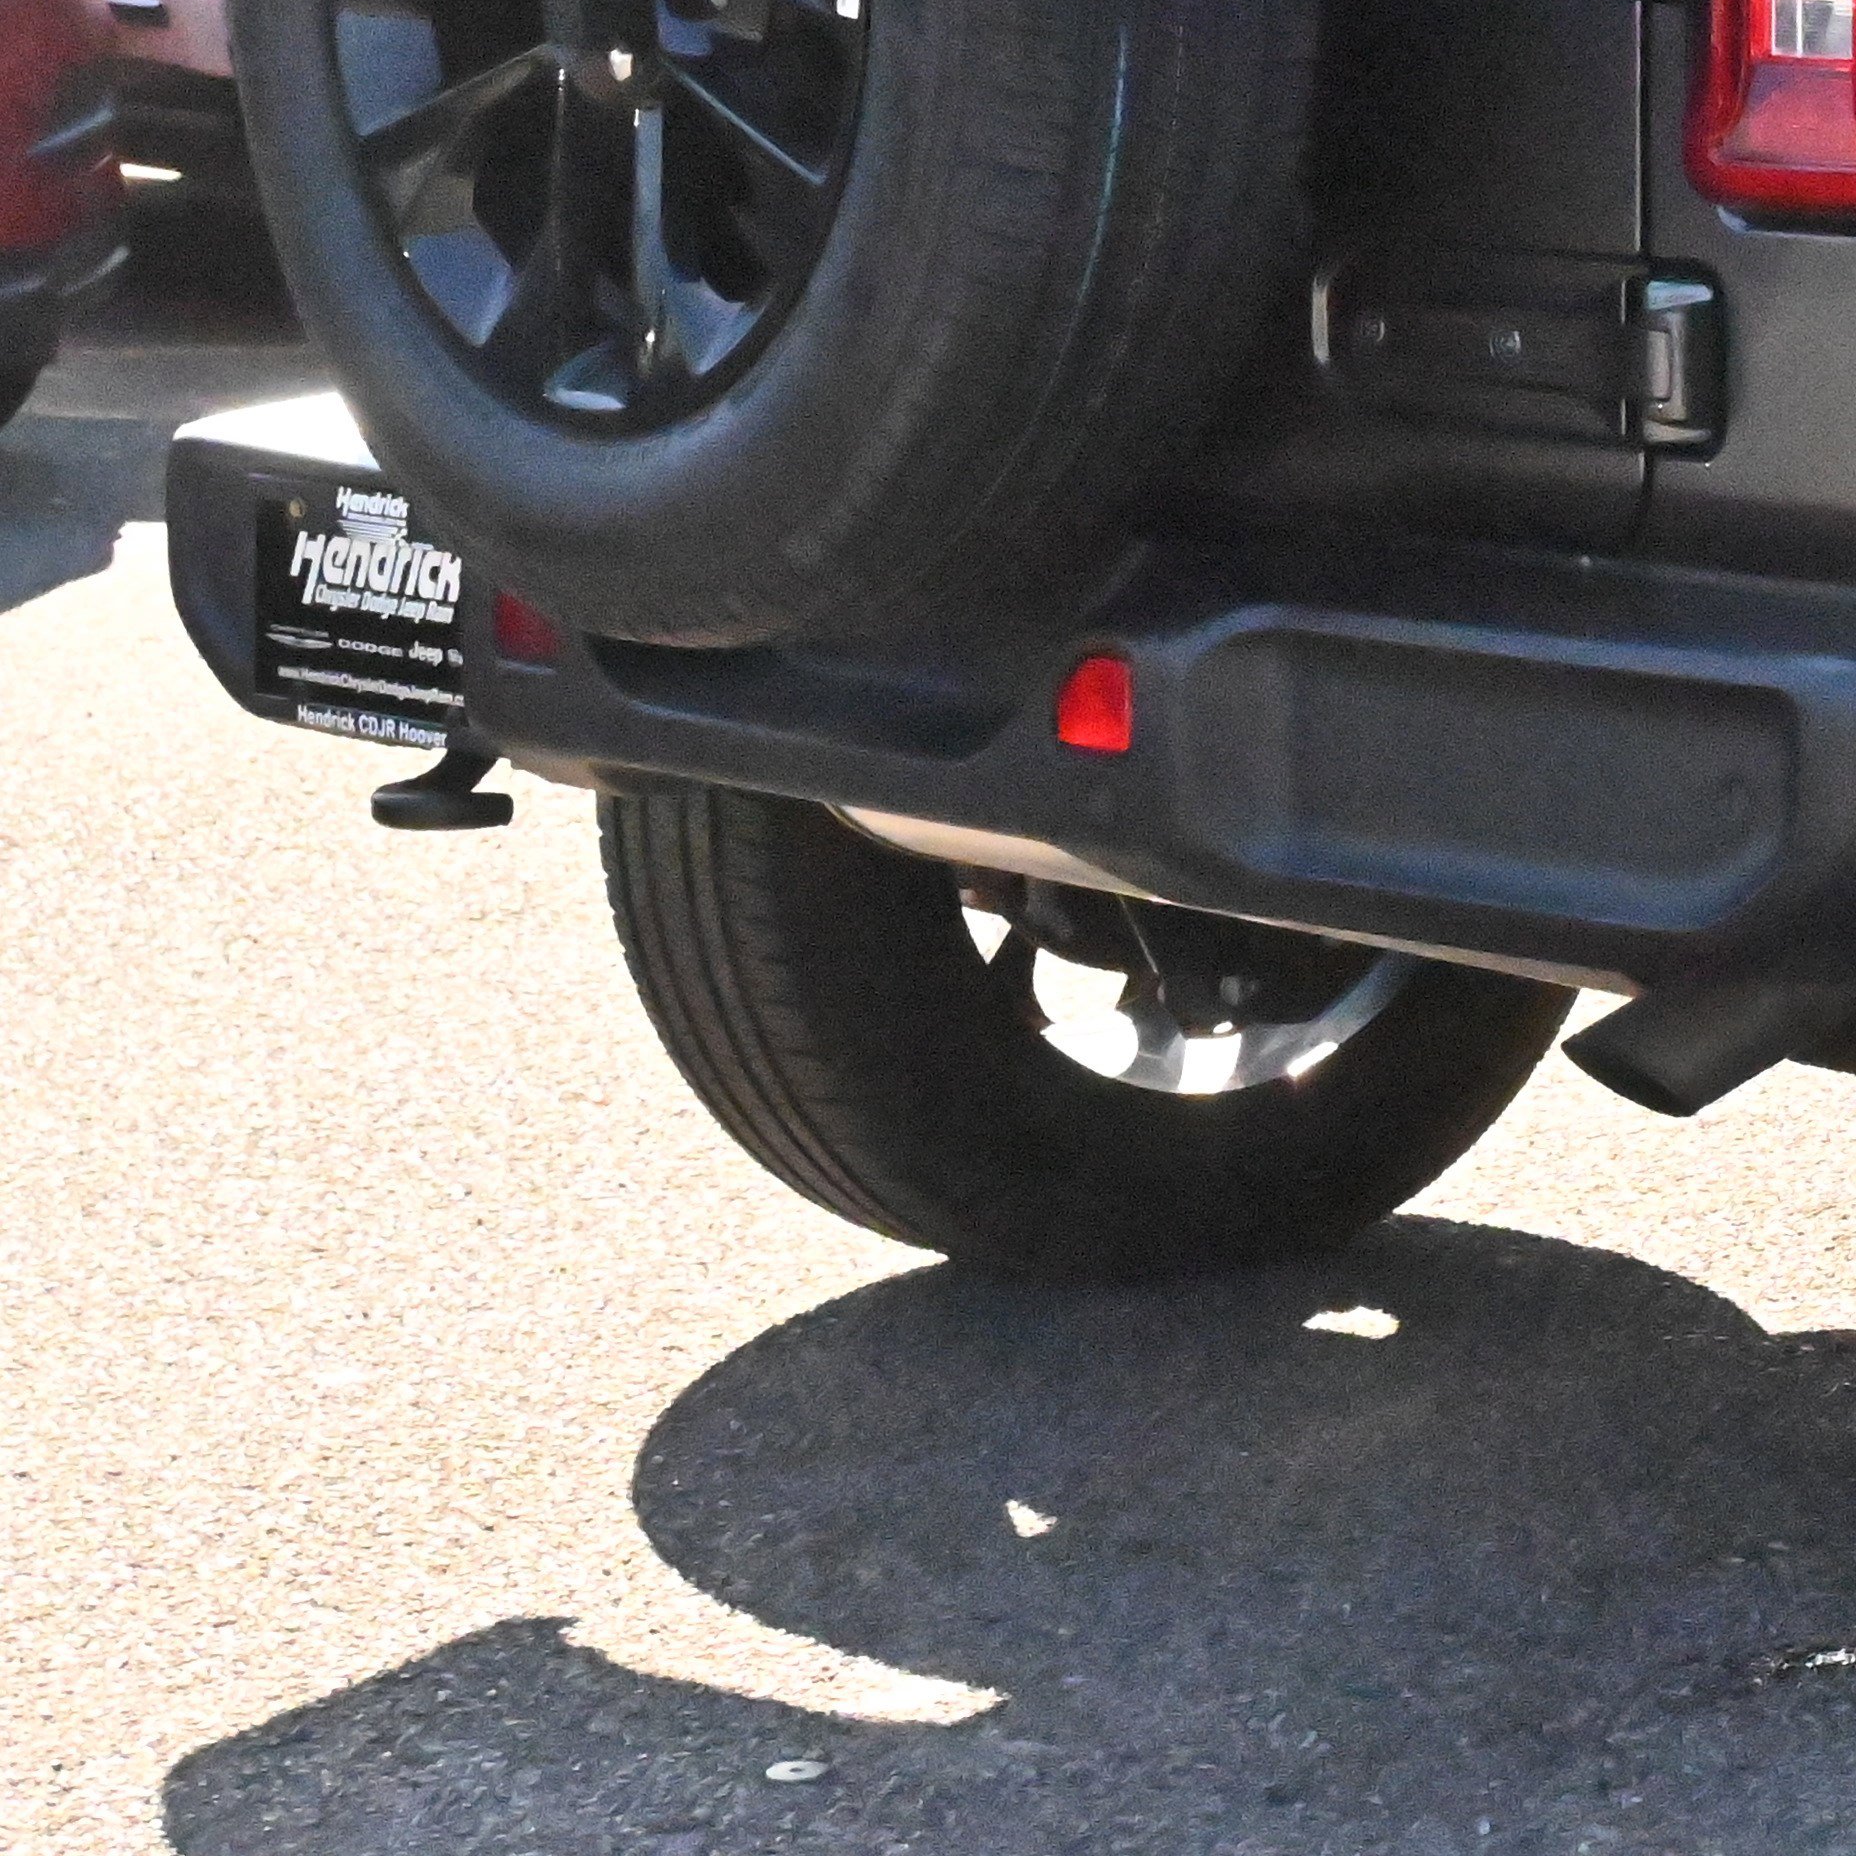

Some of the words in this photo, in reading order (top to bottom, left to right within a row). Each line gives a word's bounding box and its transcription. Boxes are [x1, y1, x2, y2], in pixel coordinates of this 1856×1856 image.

[335, 485, 410, 518] Hendrick
[290, 530, 463, 605] Hendrick
[408, 640, 443, 667] Jeep
[297, 704, 356, 733] Hendrick
[358, 714, 396, 740] CDJR
[399, 723, 448, 748] Hoover
